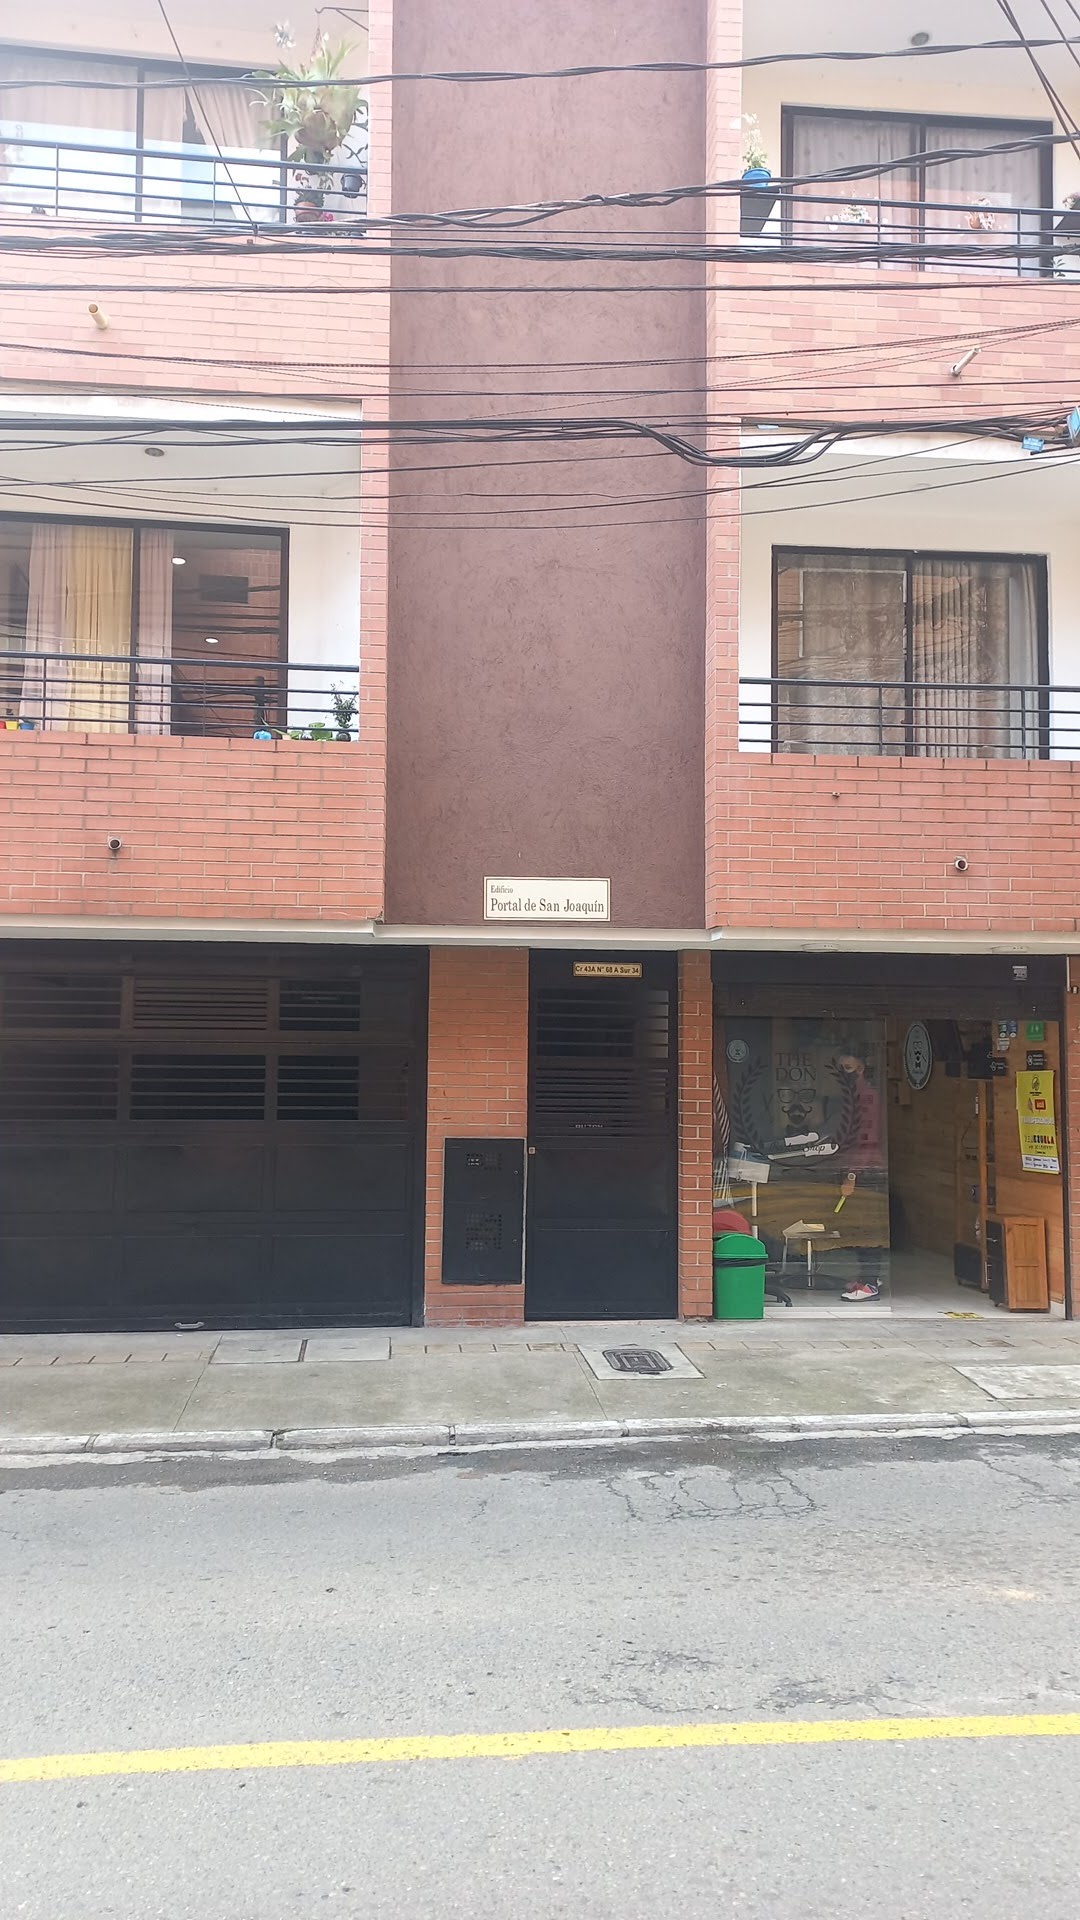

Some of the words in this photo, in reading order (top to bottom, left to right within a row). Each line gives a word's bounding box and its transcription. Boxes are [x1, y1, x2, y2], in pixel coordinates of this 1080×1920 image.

[490, 885, 514, 894] Edificio
[490, 898, 522, 912] Portal
[524, 898, 537, 912] de
[539, 898, 560, 912] San
[563, 899, 605, 915] Joaquín
[775, 1053, 812, 1067] THE
[776, 1067, 817, 1081] DON
